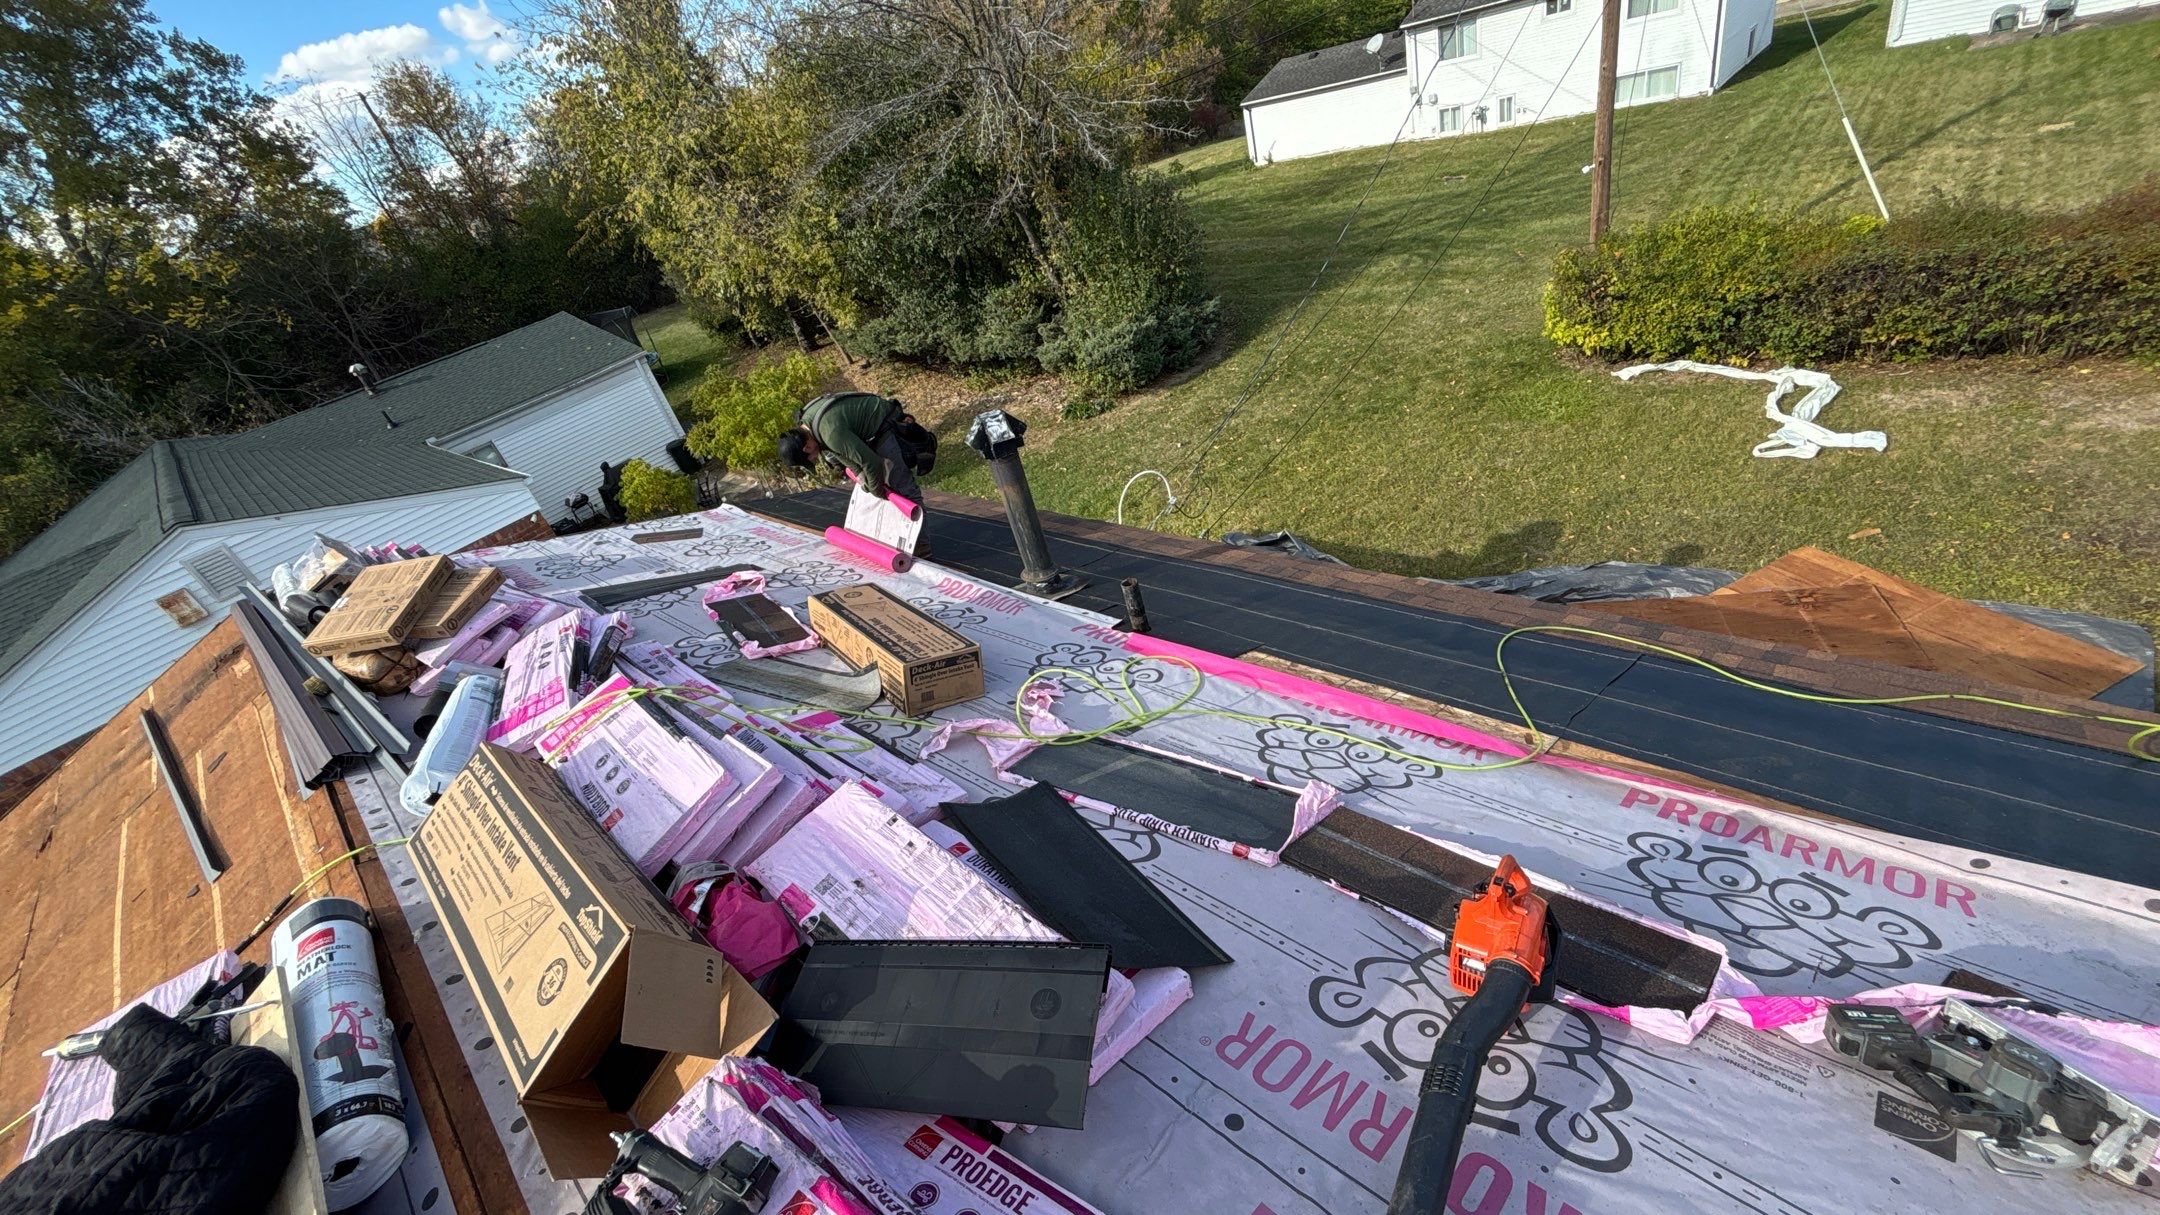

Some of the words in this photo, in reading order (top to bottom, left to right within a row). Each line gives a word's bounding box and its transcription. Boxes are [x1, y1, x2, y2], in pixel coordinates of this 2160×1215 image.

[912, 661, 945, 675] Deck-Air
[468, 751, 497, 791] Deck-Air
[581, 780, 610, 818] DURATION
[1113, 807, 1140, 822] PLUS
[457, 777, 484, 817] Shingle
[475, 801, 494, 829] Over
[485, 816, 510, 853] Intake
[500, 839, 523, 873] Vent
[1140, 815, 1170, 834] STRIP
[1172, 826, 1219, 850] STARTER
[1620, 788, 1977, 918] PROARMOR
[297, 951, 337, 981] MAT
[1881, 1097, 1950, 1131] CORNING
[1881, 1104, 1938, 1132] OWENS
[940, 1145, 1036, 1215] PROEDGE
